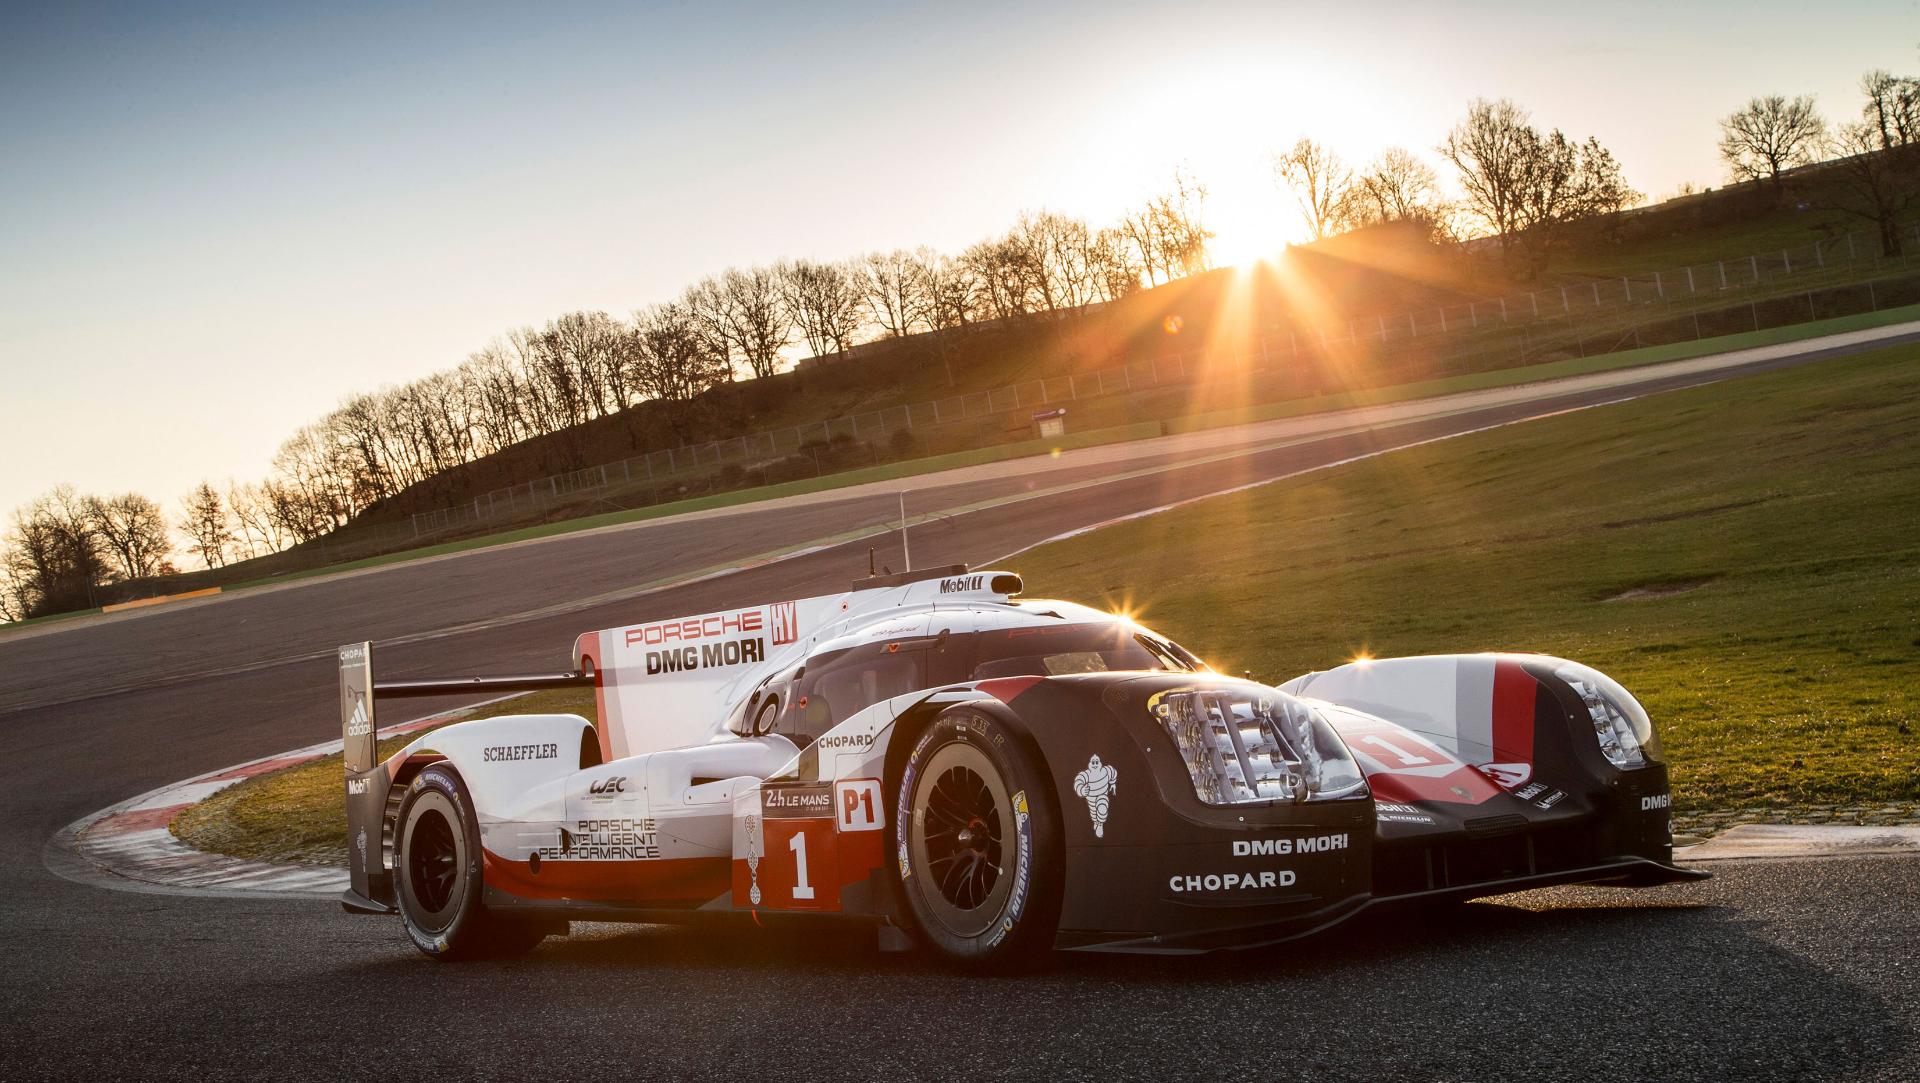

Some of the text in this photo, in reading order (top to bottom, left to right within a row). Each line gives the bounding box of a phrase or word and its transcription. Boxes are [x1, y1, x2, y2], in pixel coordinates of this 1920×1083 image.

[940, 577, 971, 594] Mobil
[626, 611, 762, 648] PORSCHE
[770, 602, 797, 645] HY
[646, 638, 764, 675] DMG MORI
[348, 723, 371, 737] adidas
[819, 734, 873, 749] CHOPARD
[1363, 736, 1432, 765] 1
[484, 744, 557, 761] SCHAEFFLER
[425, 773, 453, 791] MICHELIN
[590, 776, 626, 793] WEC
[766, 789, 829, 807] 24h LE MANS
[843, 788, 875, 825] P1
[1641, 794, 1667, 811] DMG
[578, 819, 656, 832] PORSCHE
[558, 833, 657, 846] INTELLIGENT
[1232, 833, 1348, 857] DMG MORI
[539, 847, 660, 860] PERFORMANCE
[790, 832, 815, 899] 1
[1012, 834, 1028, 916] MICHELIN
[1169, 870, 1296, 892] CHOPARD
